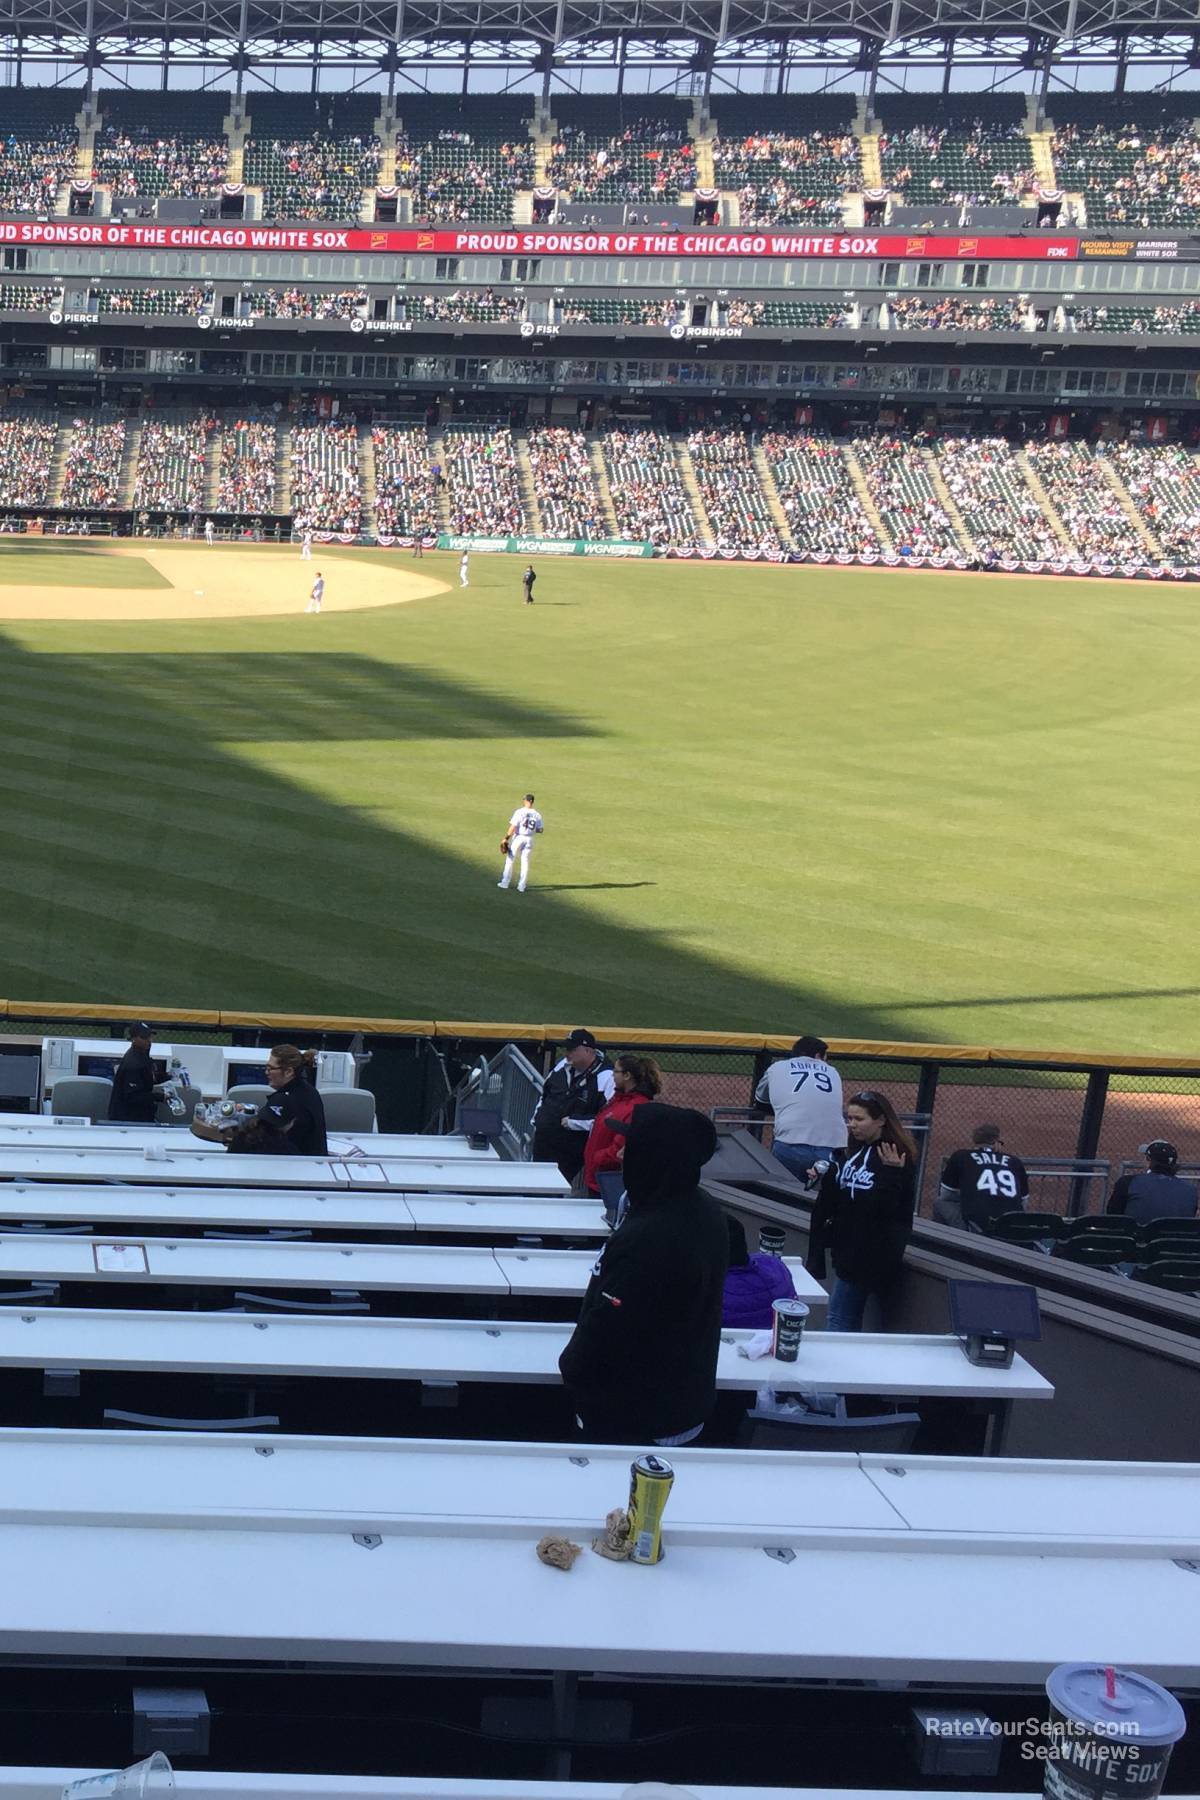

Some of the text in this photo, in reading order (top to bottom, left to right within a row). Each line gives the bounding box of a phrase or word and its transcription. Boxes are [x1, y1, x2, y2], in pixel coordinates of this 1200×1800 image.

[21, 224, 102, 242] SPONSOR
[107, 228, 129, 243] OF
[135, 228, 165, 244] THE
[170, 229, 246, 246] CHICAGO
[251, 231, 308, 247] WHITE
[312, 232, 349, 248] SOX
[456, 234, 879, 254] PROUD SPONSOR OF THE CHICAGO WHITE SOX
[1081, 241, 1135, 249] MOUND VISITS
[1047, 247, 1068, 257] FDIC
[1085, 248, 1128, 256] REMAINING
[64, 313, 99, 323] PIERCE
[213, 318, 254, 328] THOMAS
[366, 321, 412, 331] BUEHRLE
[536, 325, 560, 334] FISK
[686, 327, 742, 337] ROBINSON
[449, 538, 477, 549] WGN
[516, 541, 542, 550] WGN
[584, 544, 612, 554] WGN
[522, 819, 537, 831] 49
[790, 1061, 828, 1073] ABREU
[790, 1072, 833, 1093] 79
[970, 1152, 1010, 1167] SALE
[976, 1169, 1017, 1198] 49
[363, 1537, 372, 1545] 5
[1061, 1736, 1122, 1780] WHITE
[1125, 1762, 1162, 1783] SOX
